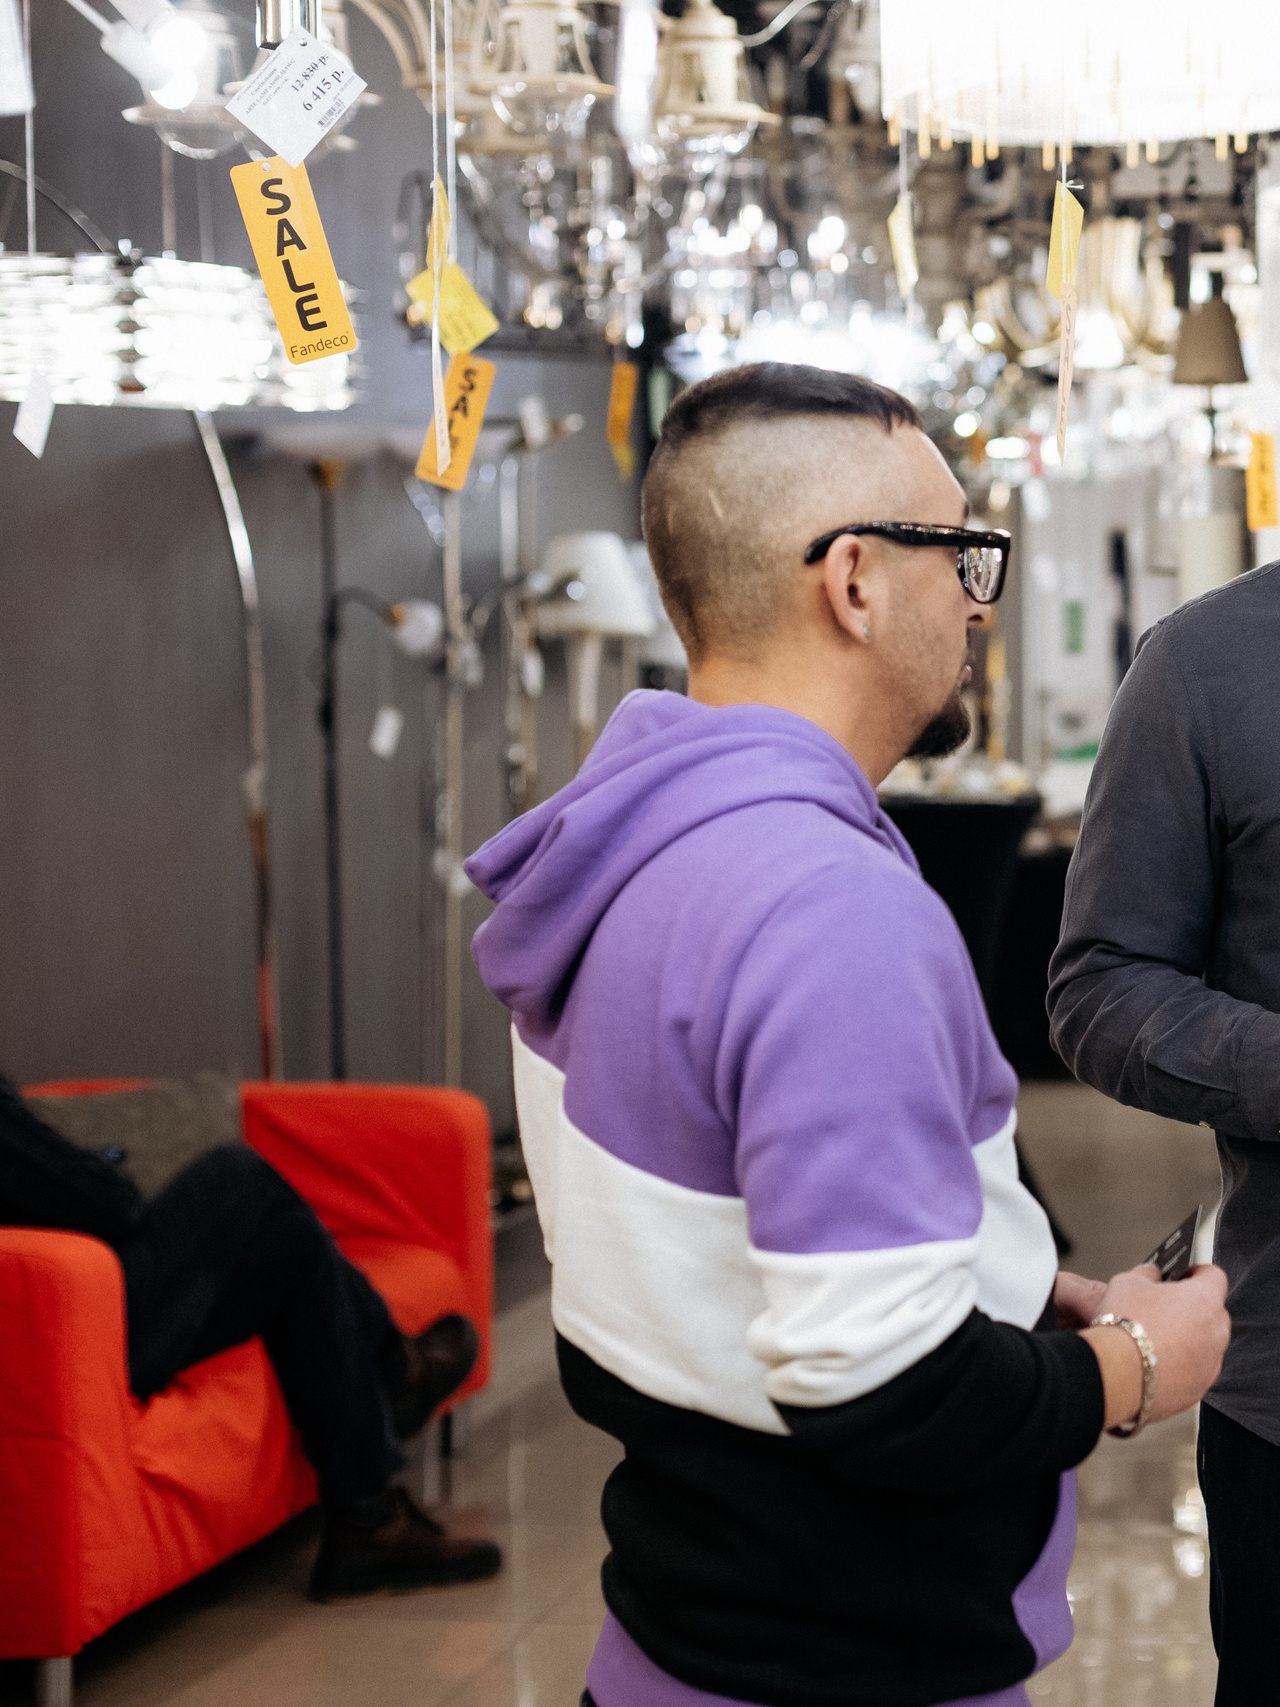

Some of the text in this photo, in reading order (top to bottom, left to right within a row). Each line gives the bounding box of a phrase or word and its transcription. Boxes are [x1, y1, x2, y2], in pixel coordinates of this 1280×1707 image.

[291, 79, 305, 92] 12
[301, 62, 319, 81] 830
[302, 102, 313, 111] 6
[312, 77, 332, 101] 415
[260, 177, 328, 332] SALE
[290, 334, 349, 358] Fandeco
